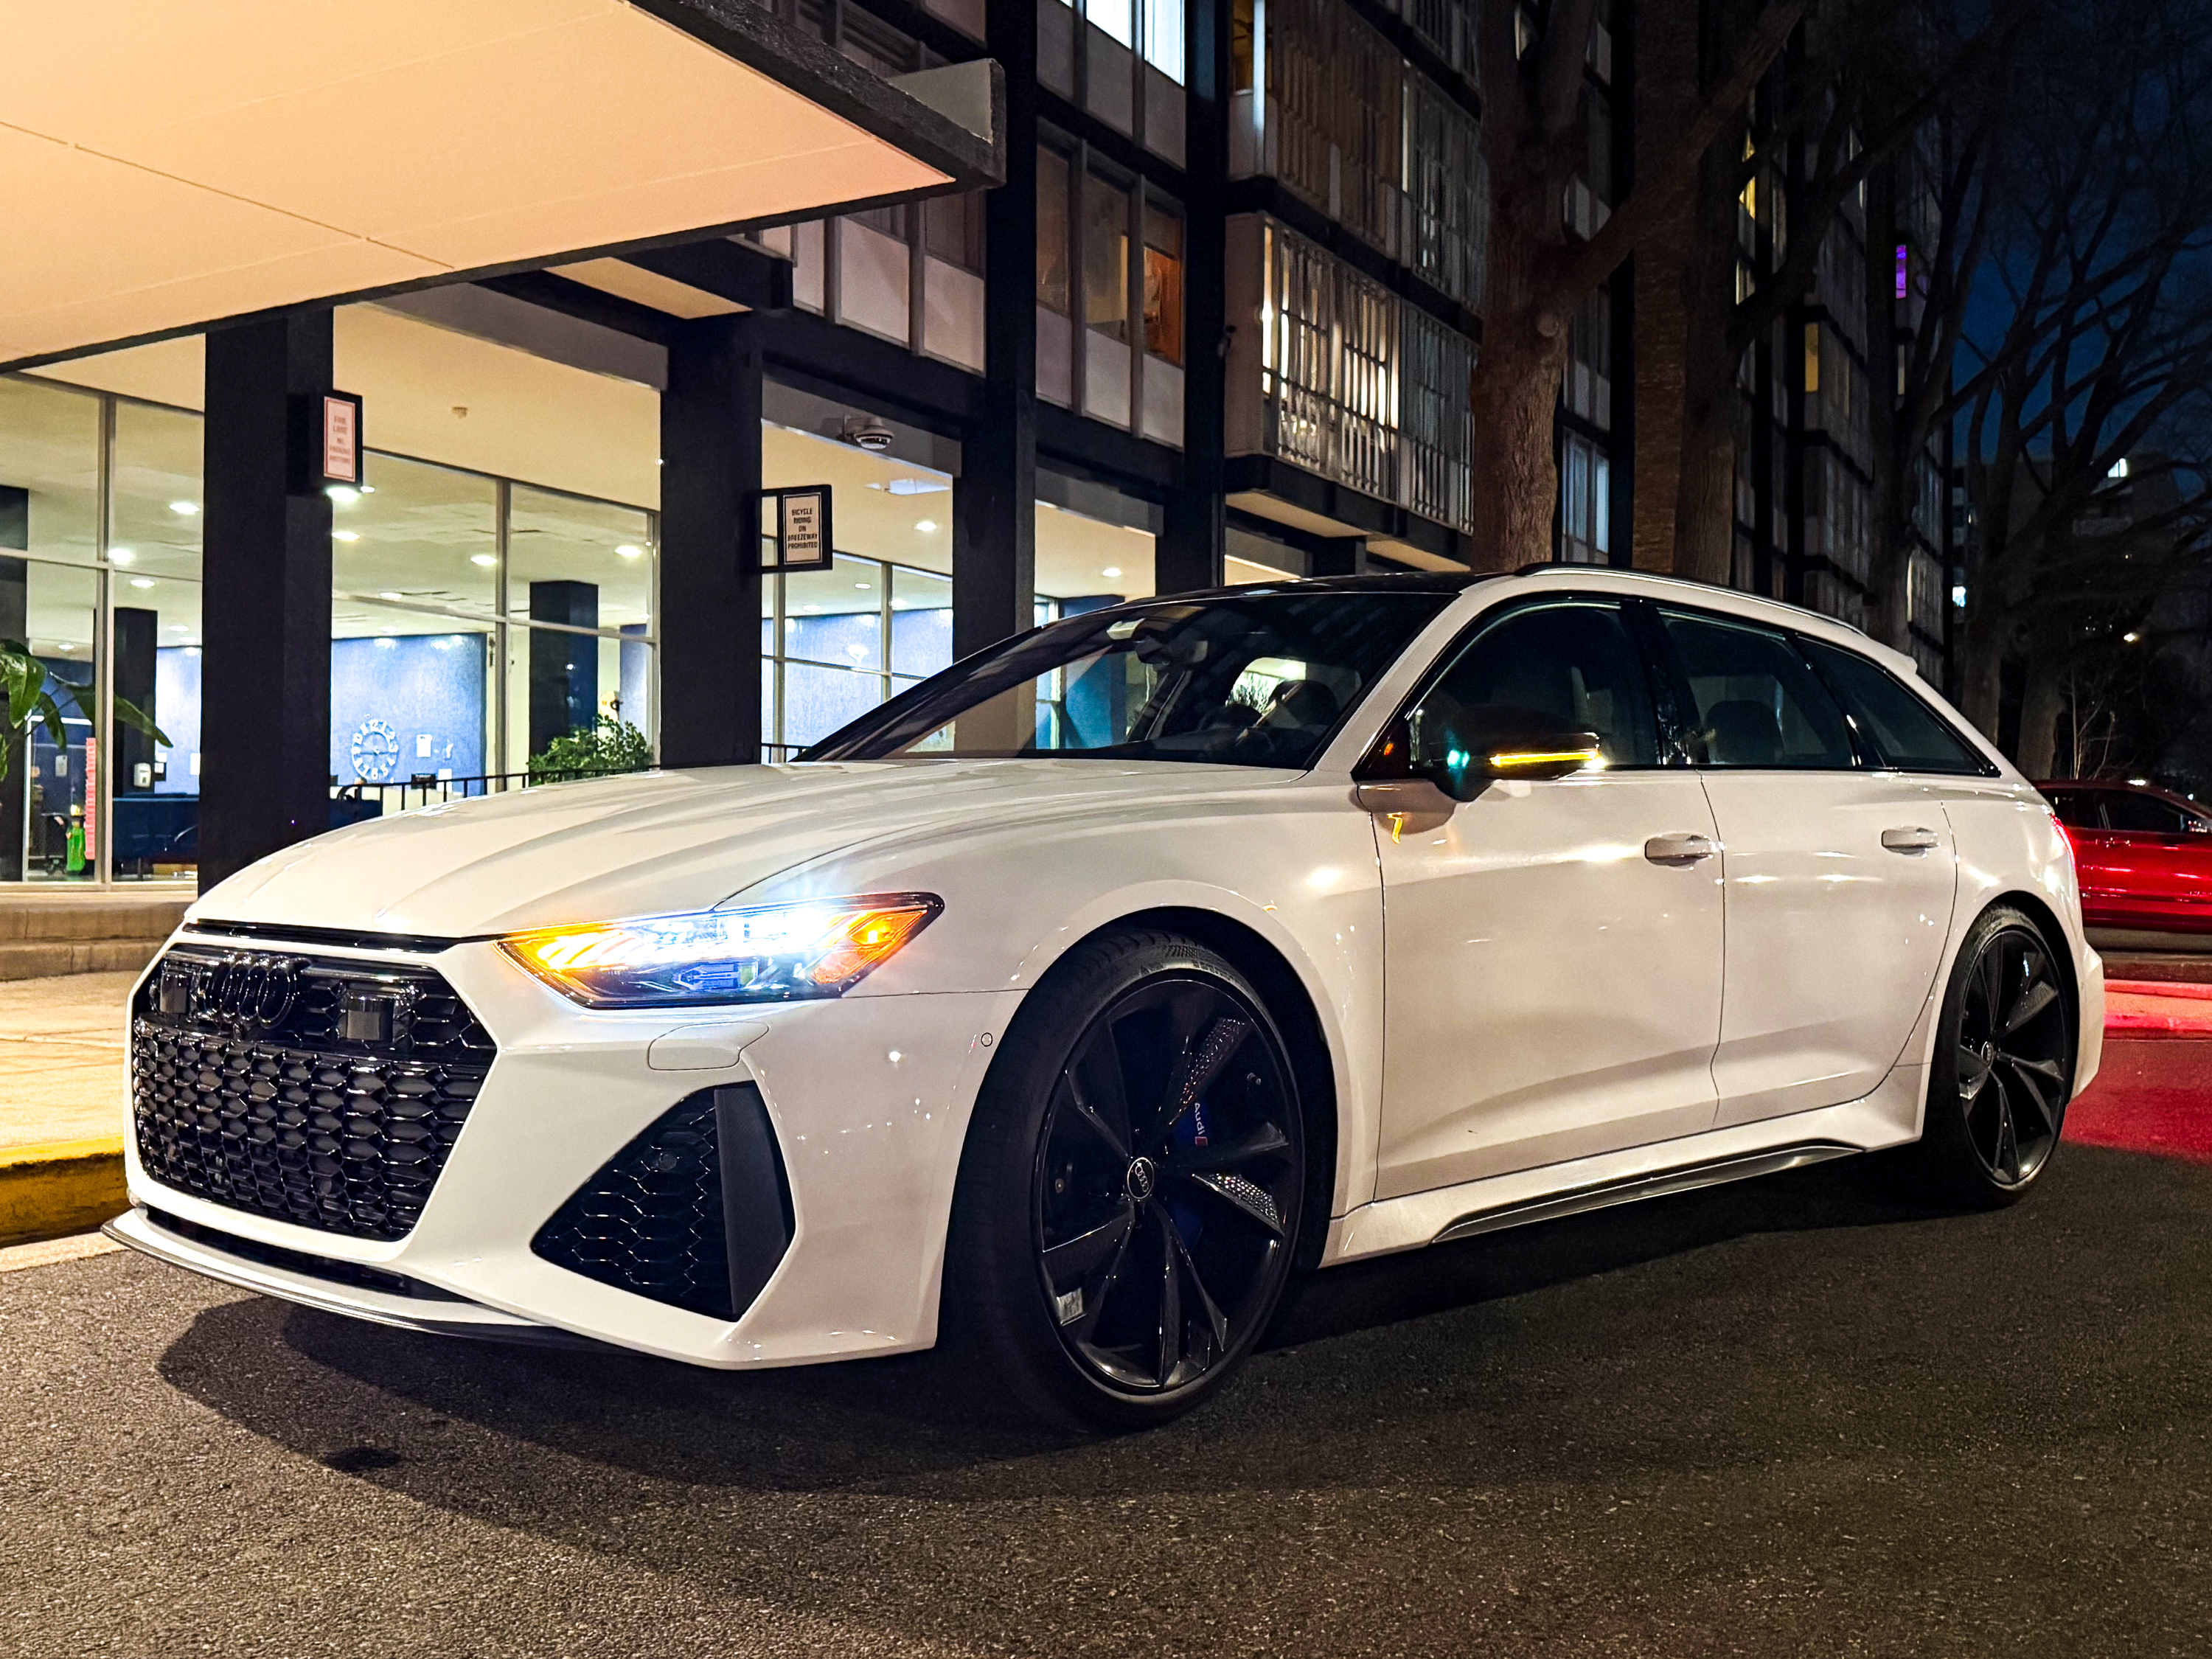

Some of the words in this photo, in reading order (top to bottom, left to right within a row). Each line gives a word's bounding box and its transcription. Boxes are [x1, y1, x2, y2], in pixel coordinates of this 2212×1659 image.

[792, 508, 812, 516] BICYCLE
[787, 533, 817, 542] BREEZEWAY
[1194, 1102, 1206, 1135] Audi
